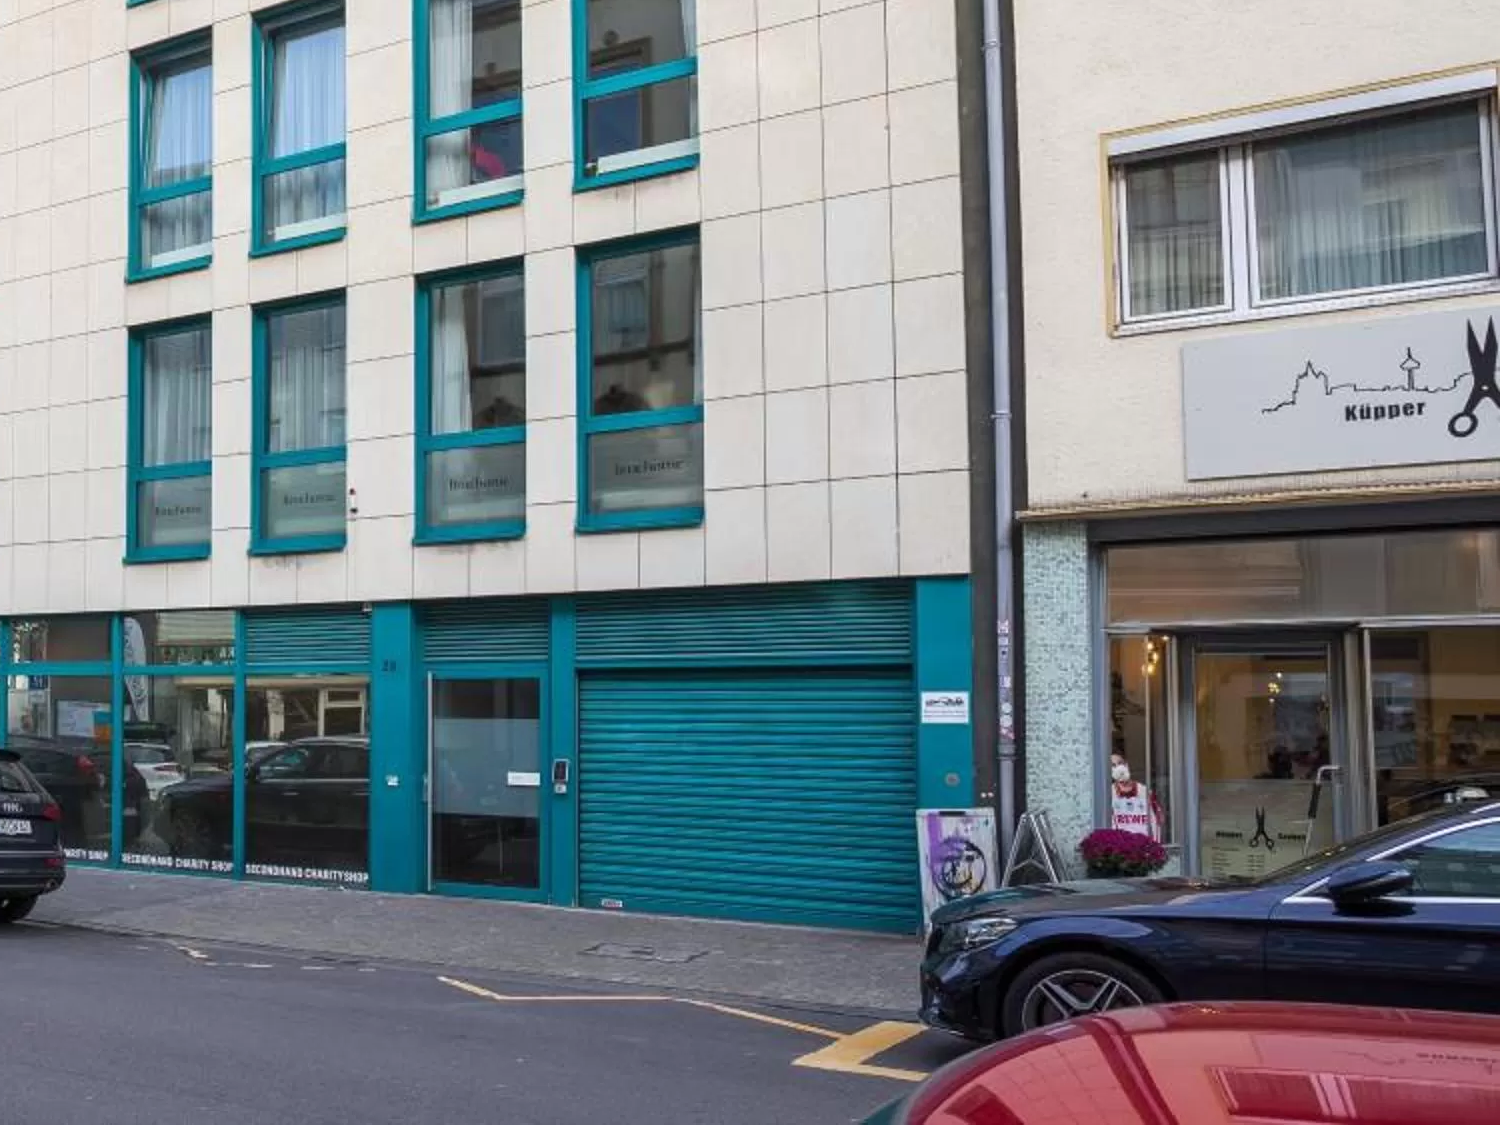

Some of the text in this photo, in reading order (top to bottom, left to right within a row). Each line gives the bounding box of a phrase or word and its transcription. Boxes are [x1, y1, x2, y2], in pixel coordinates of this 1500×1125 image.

[1344, 401, 1426, 422] Küpper
[175, 857, 210, 871] CHARITY
[211, 860, 235, 873] SHOP
[245, 863, 303, 878] SECONDHAND
